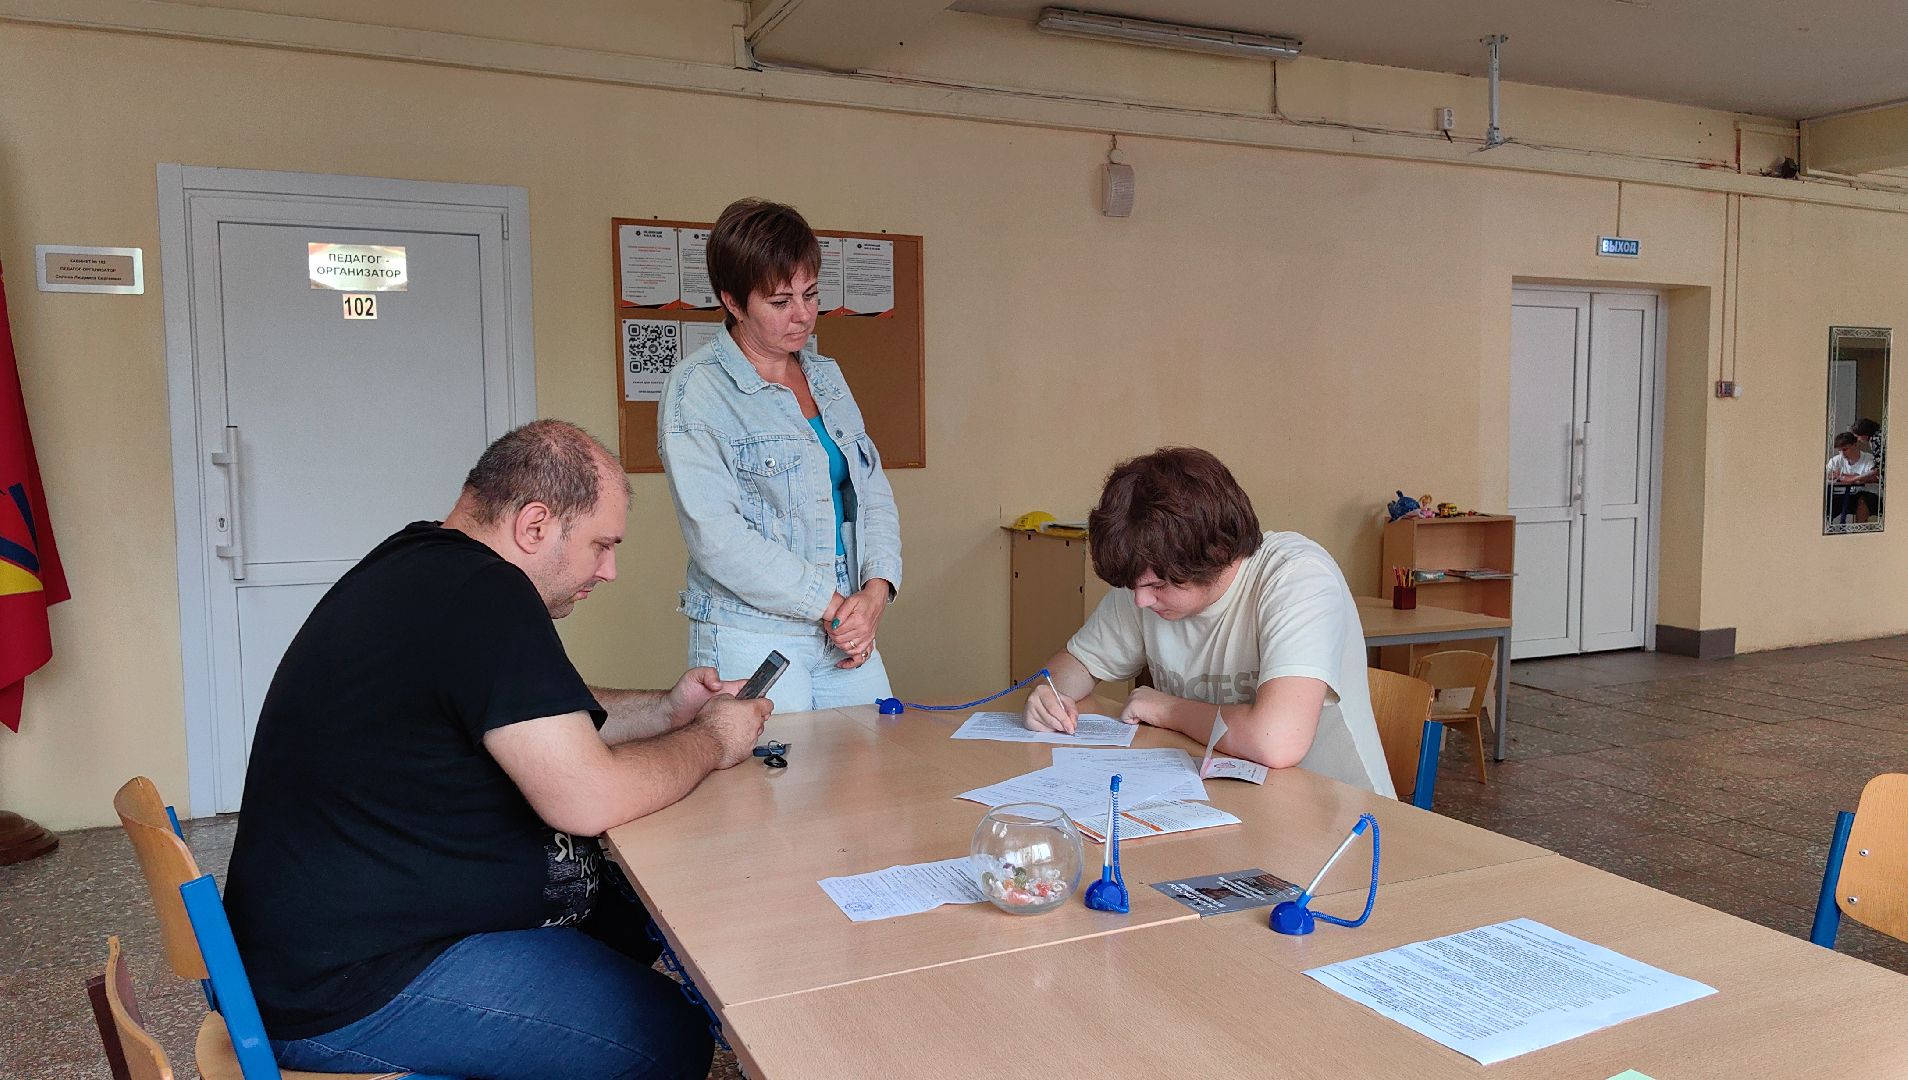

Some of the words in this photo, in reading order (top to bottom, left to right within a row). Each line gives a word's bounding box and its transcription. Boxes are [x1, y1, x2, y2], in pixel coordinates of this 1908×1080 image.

[1602, 239, 1638, 254] ВЫХОД
[328, 253, 382, 264] ПЕДАГОГ
[316, 266, 402, 278] ОРГАНИЗАТОР
[344, 297, 374, 317] 102
